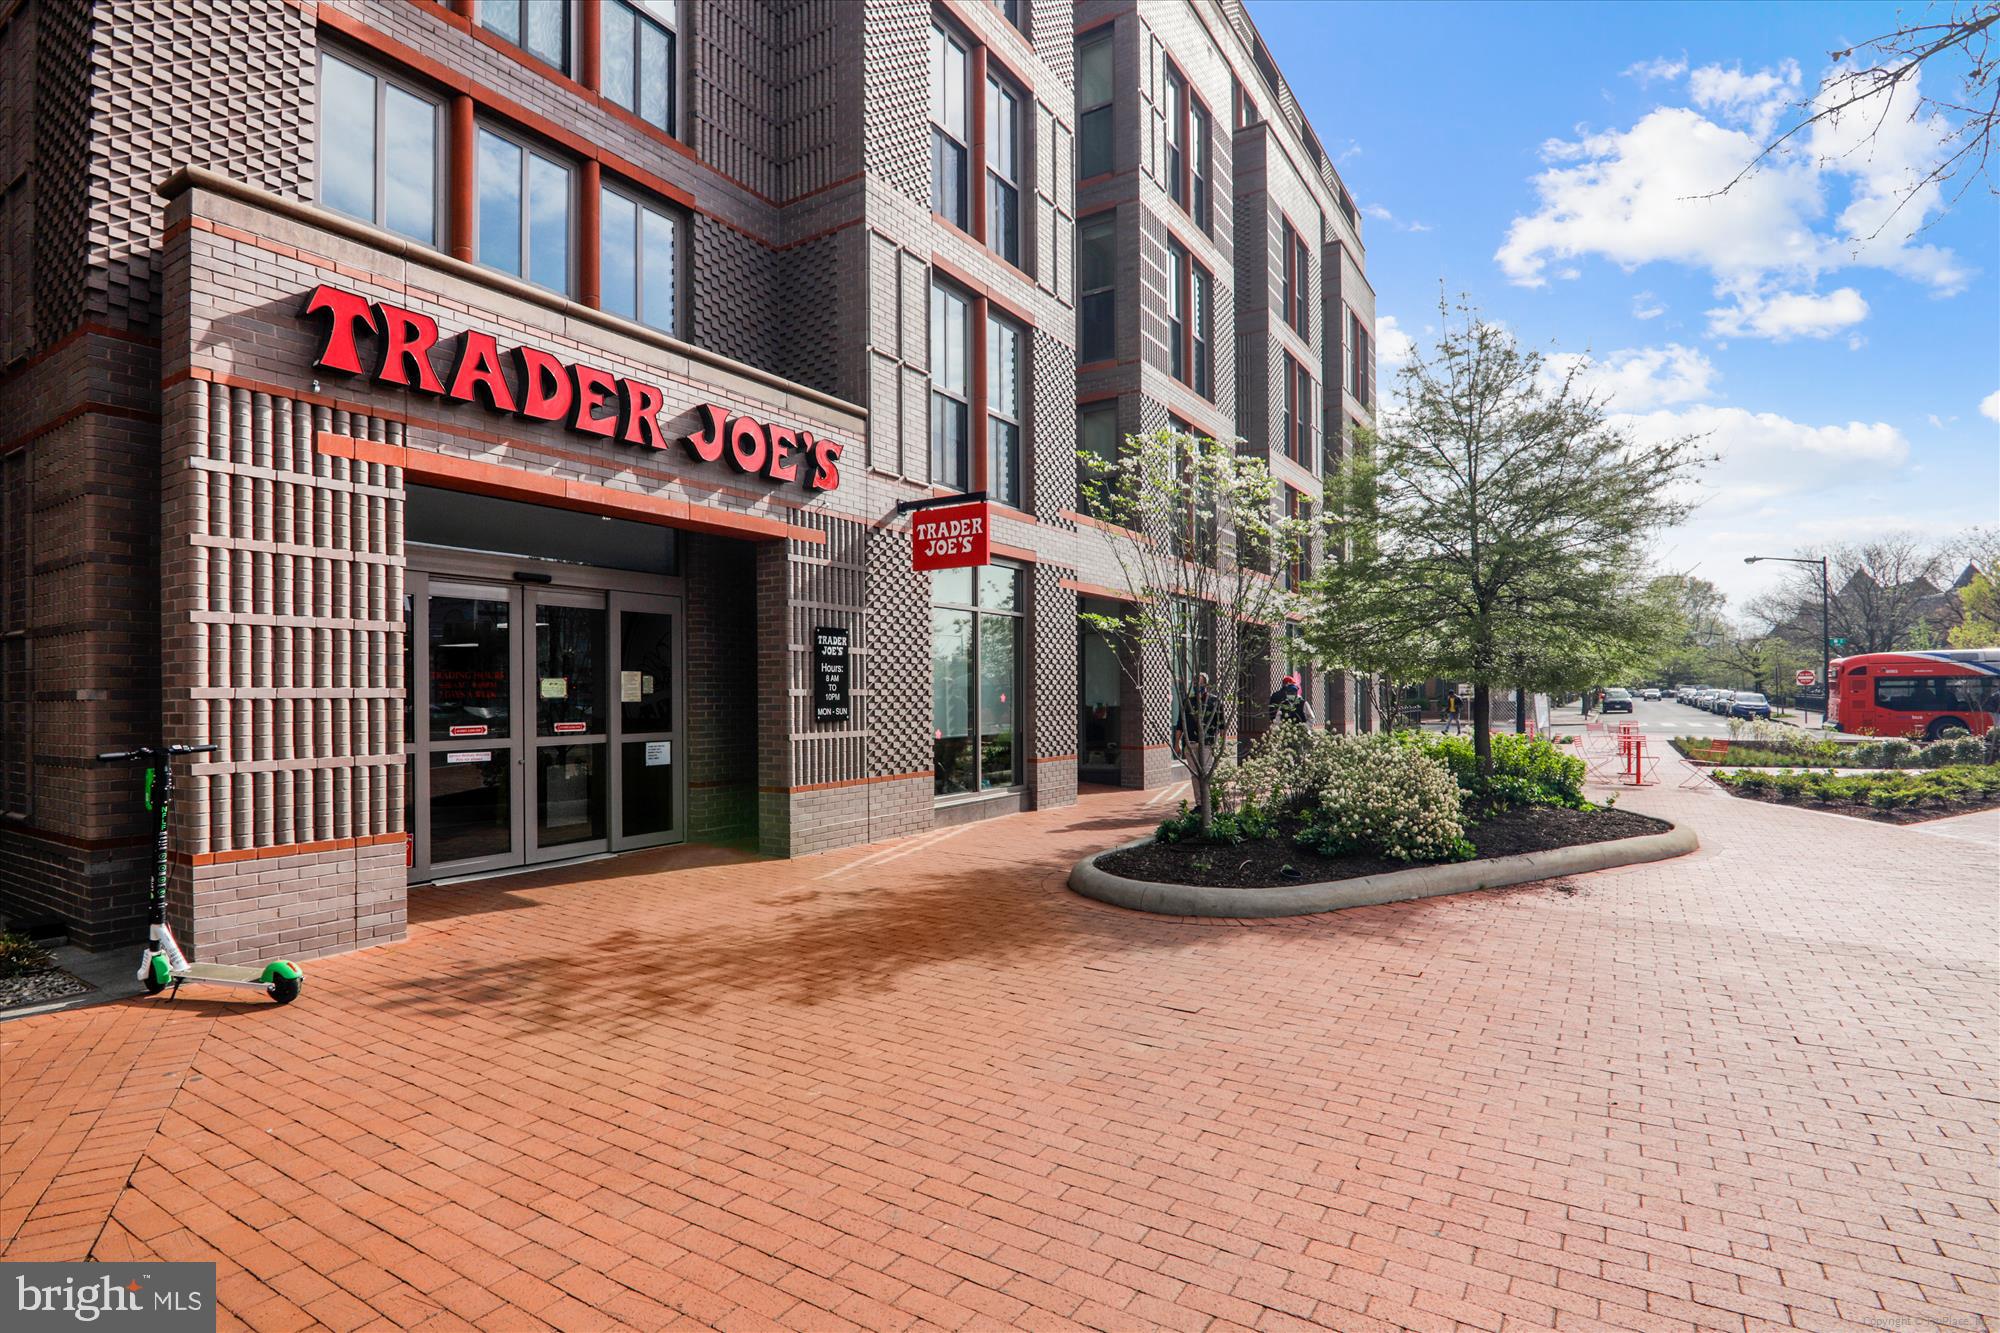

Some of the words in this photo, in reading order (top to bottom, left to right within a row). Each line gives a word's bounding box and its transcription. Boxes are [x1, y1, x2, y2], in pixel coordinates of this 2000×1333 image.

[305, 284, 669, 451] TRADER
[684, 402, 845, 492] JOE'S
[916, 517, 984, 541] TRADER
[924, 536, 974, 557] JOE'S
[817, 635, 847, 646] TRADER
[821, 646, 843, 656] JOE'S
[821, 663, 843, 673] Hours:
